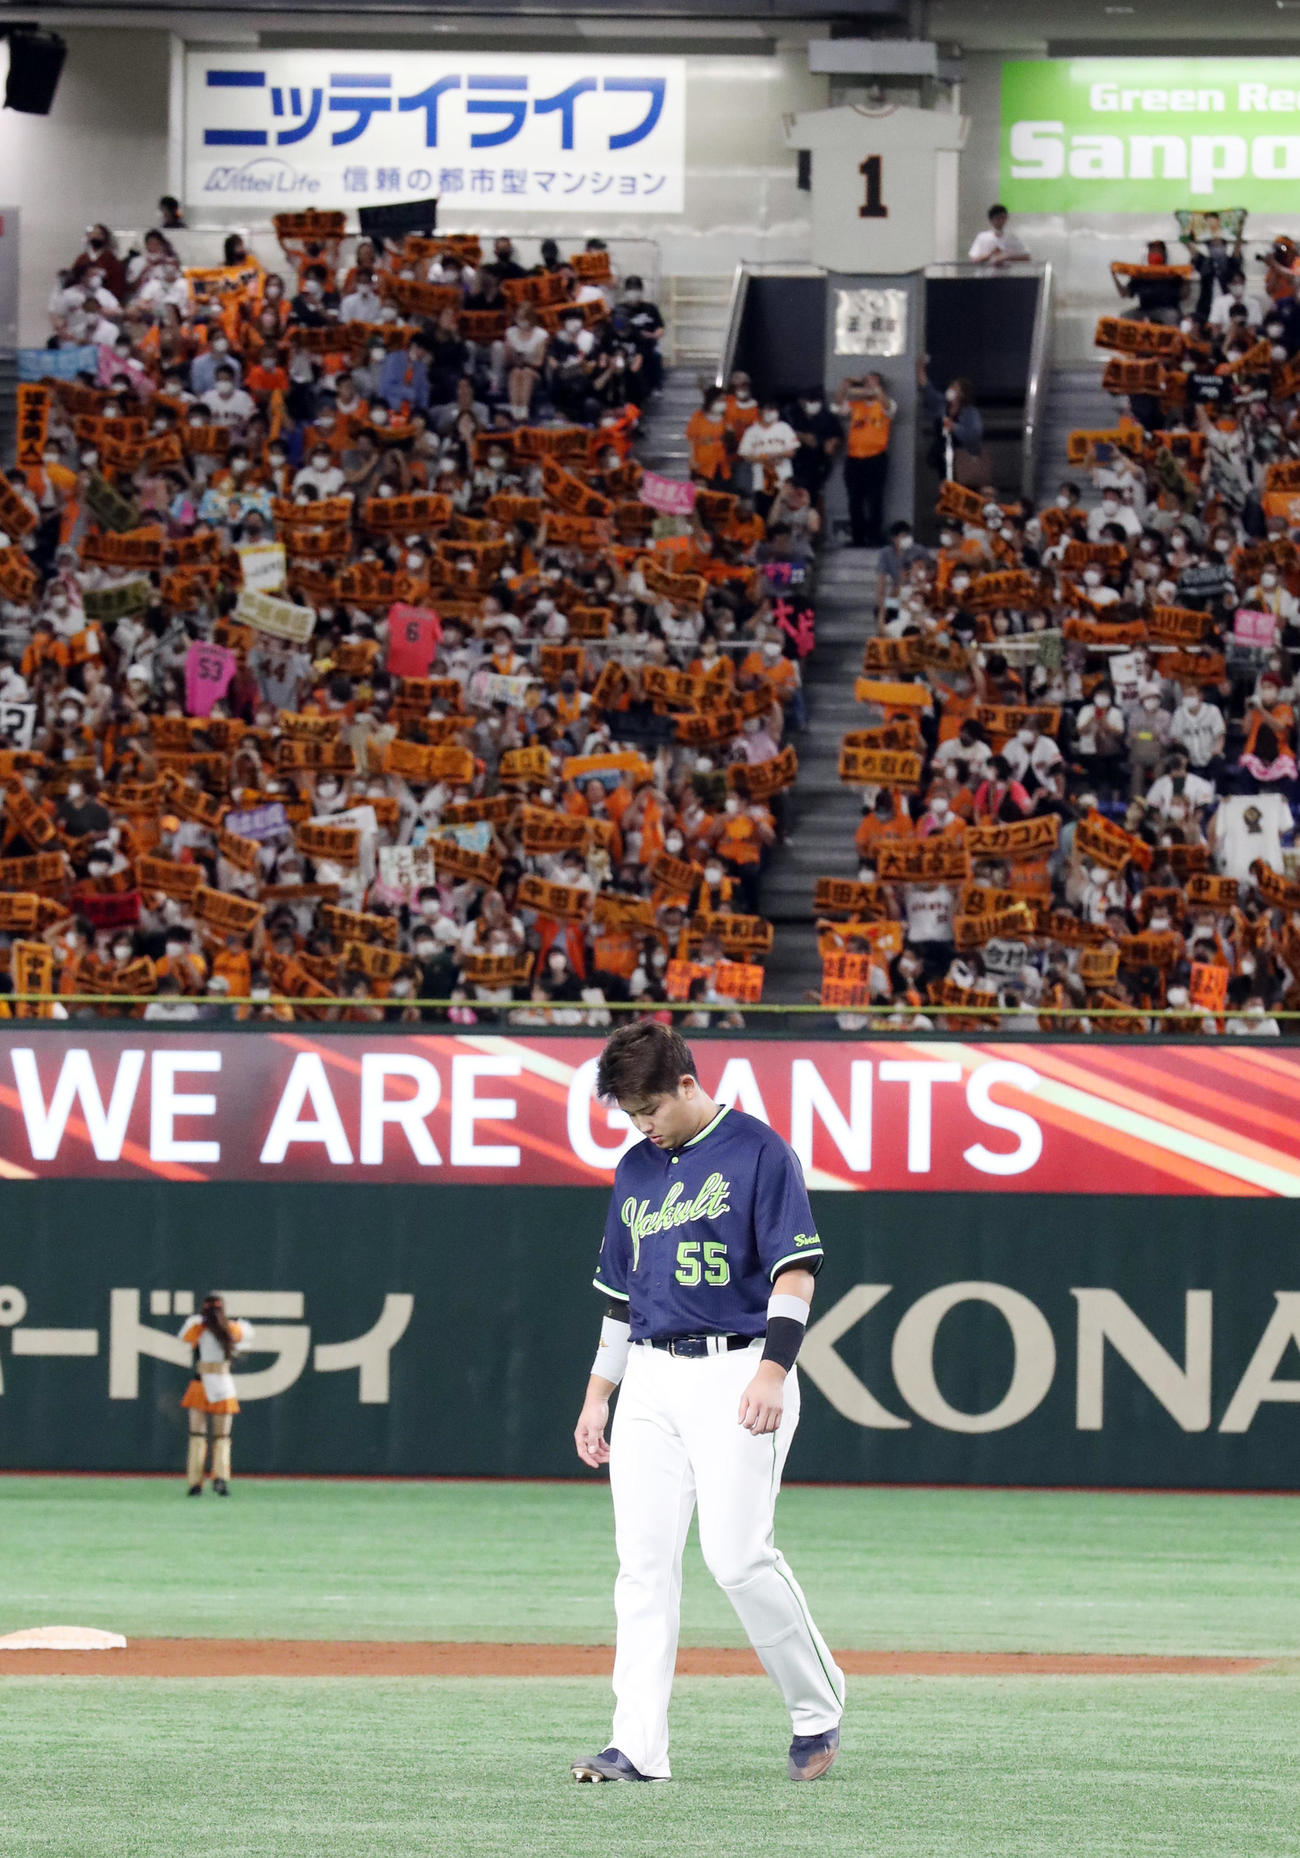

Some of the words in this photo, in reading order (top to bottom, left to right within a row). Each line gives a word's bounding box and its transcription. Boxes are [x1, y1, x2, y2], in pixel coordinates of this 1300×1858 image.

[204, 71, 666, 150] ニッテイライフ
[1090, 82, 1225, 113] Green
[1237, 82, 1300, 113] Re
[343, 166, 667, 195] 信頼の都市型マンション
[858, 154, 888, 218] 1
[1010, 120, 1300, 195] Sanpo
[10, 1048, 222, 1162] WE
[259, 1052, 523, 1167] ARE
[566, 1057, 1045, 1176] GANTS
[621, 1172, 731, 1272] Yakult
[675, 1241, 730, 1287] 55
